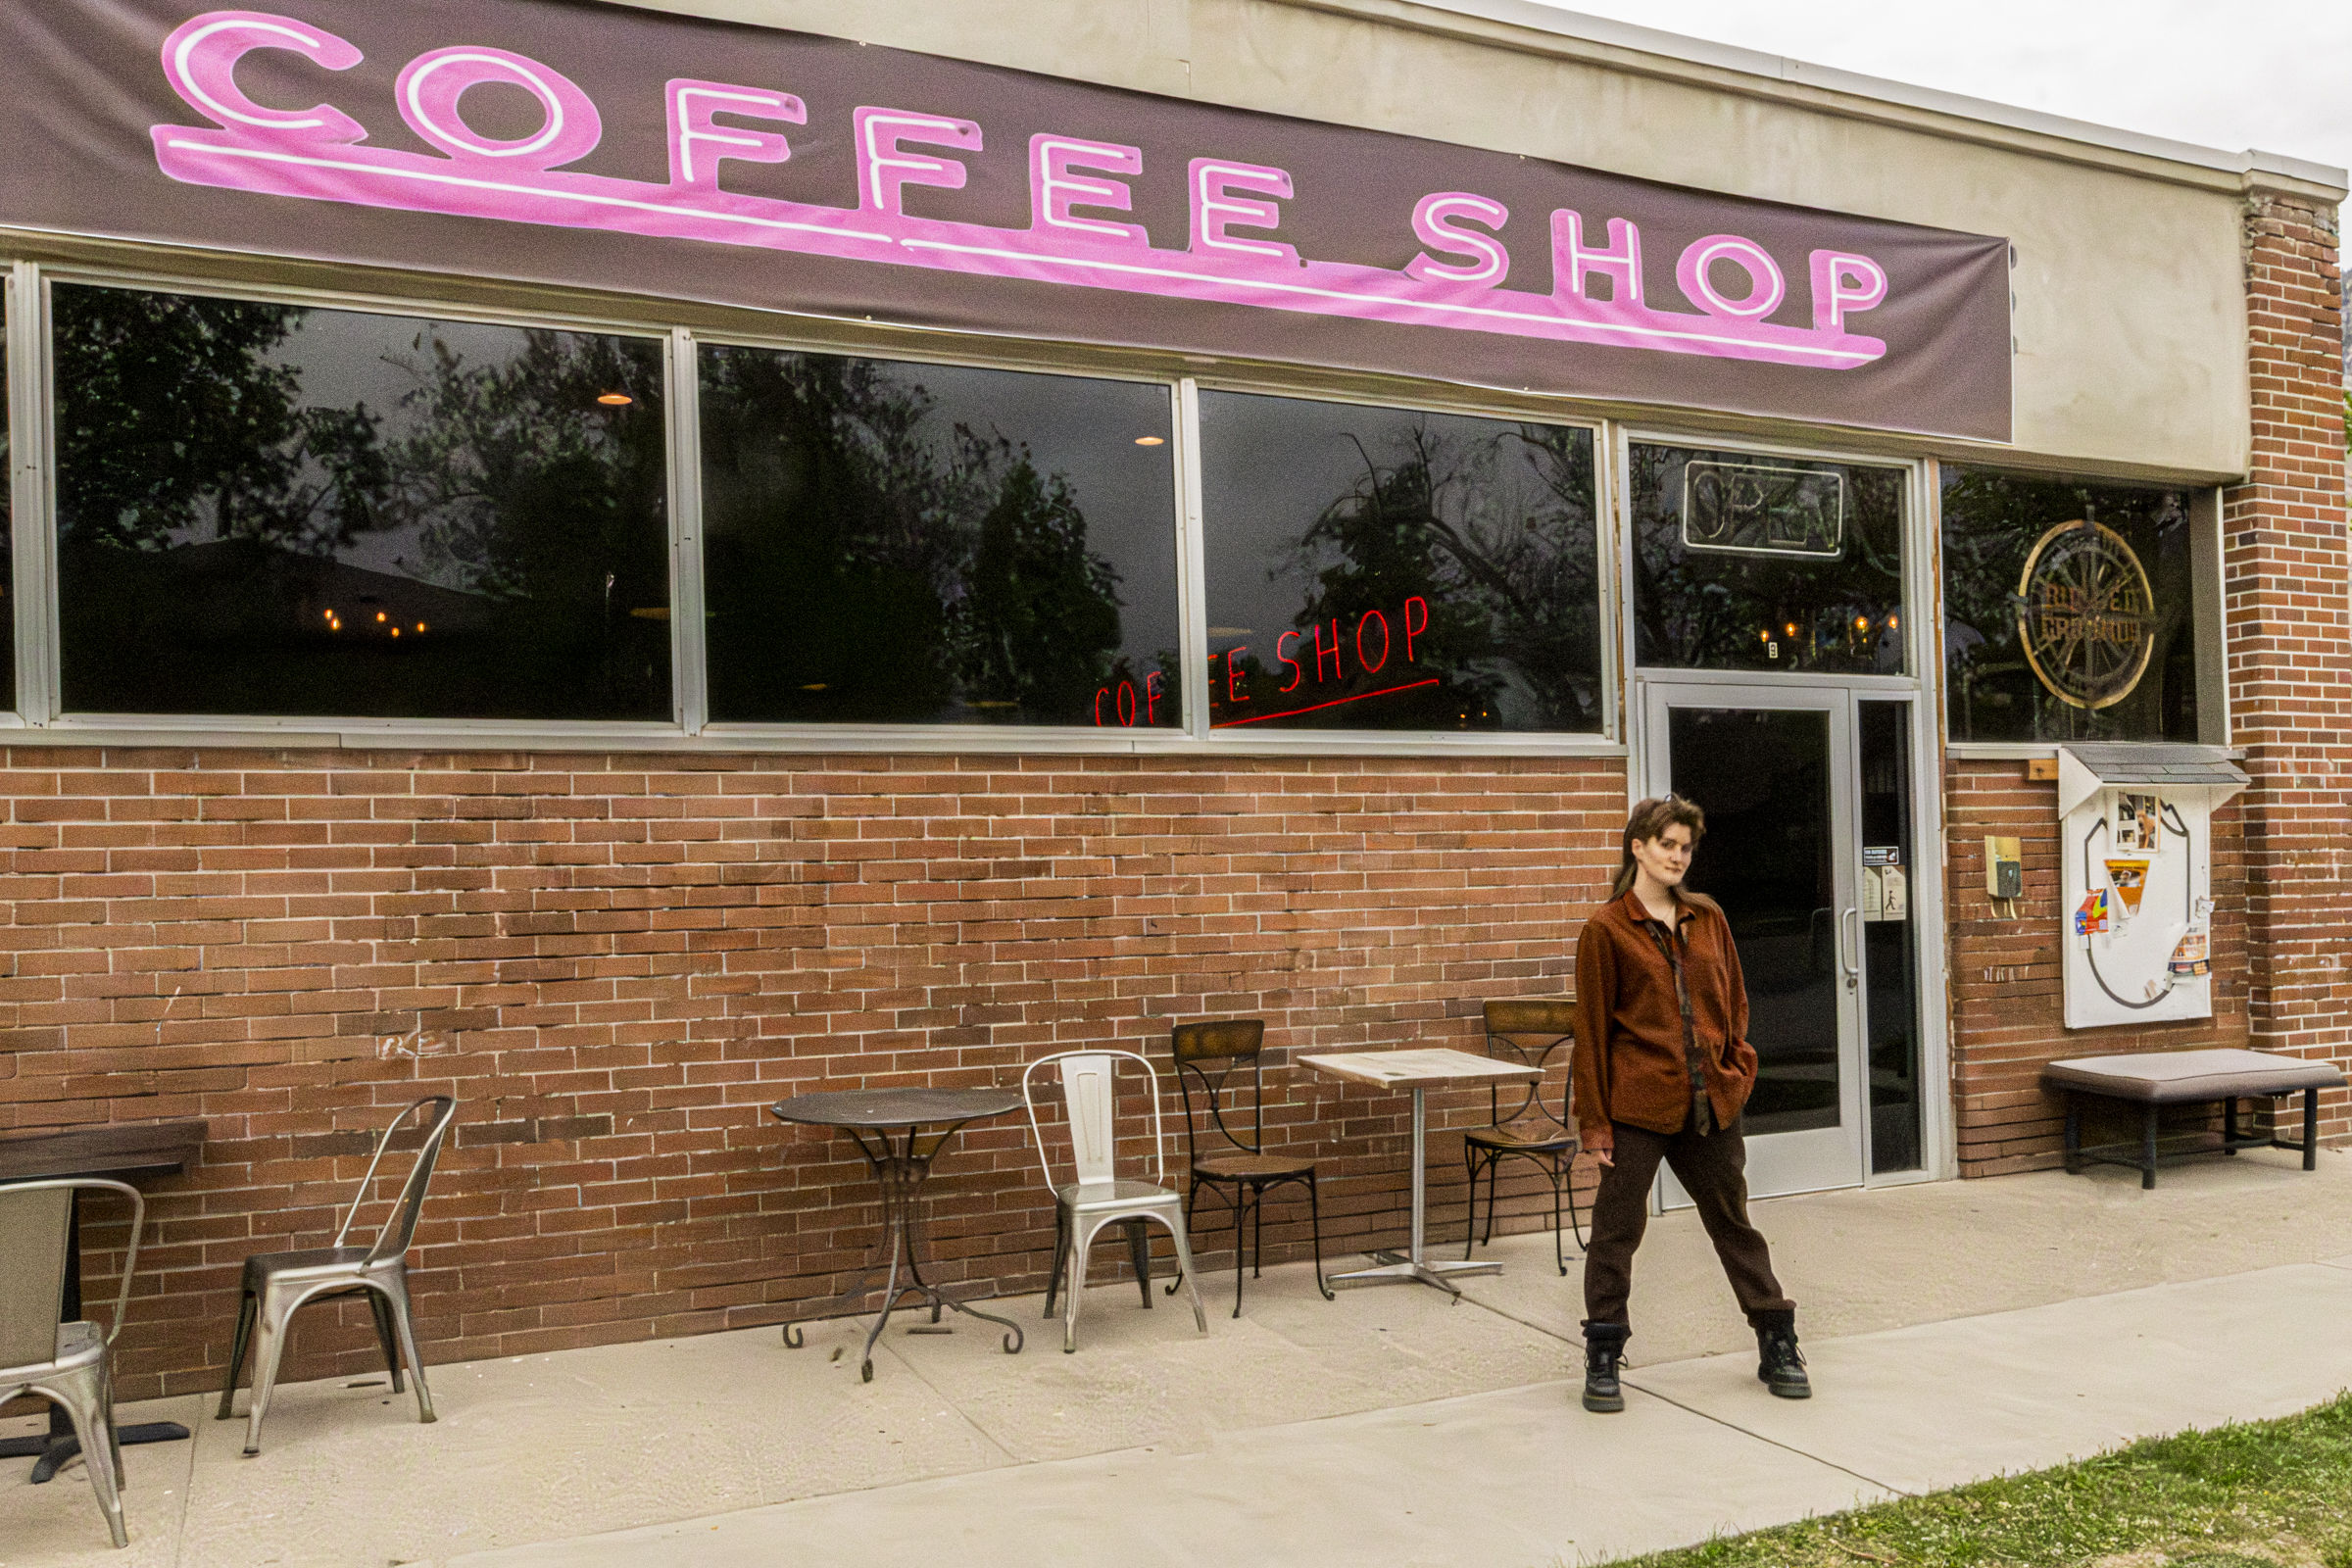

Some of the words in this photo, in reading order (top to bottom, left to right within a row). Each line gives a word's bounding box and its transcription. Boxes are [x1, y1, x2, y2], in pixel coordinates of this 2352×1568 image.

[161, 10, 1301, 267] COFFEE
[1405, 191, 1888, 333] SHOP
[1096, 645, 1250, 727] COFE
[1277, 596, 1429, 693] SHOP
